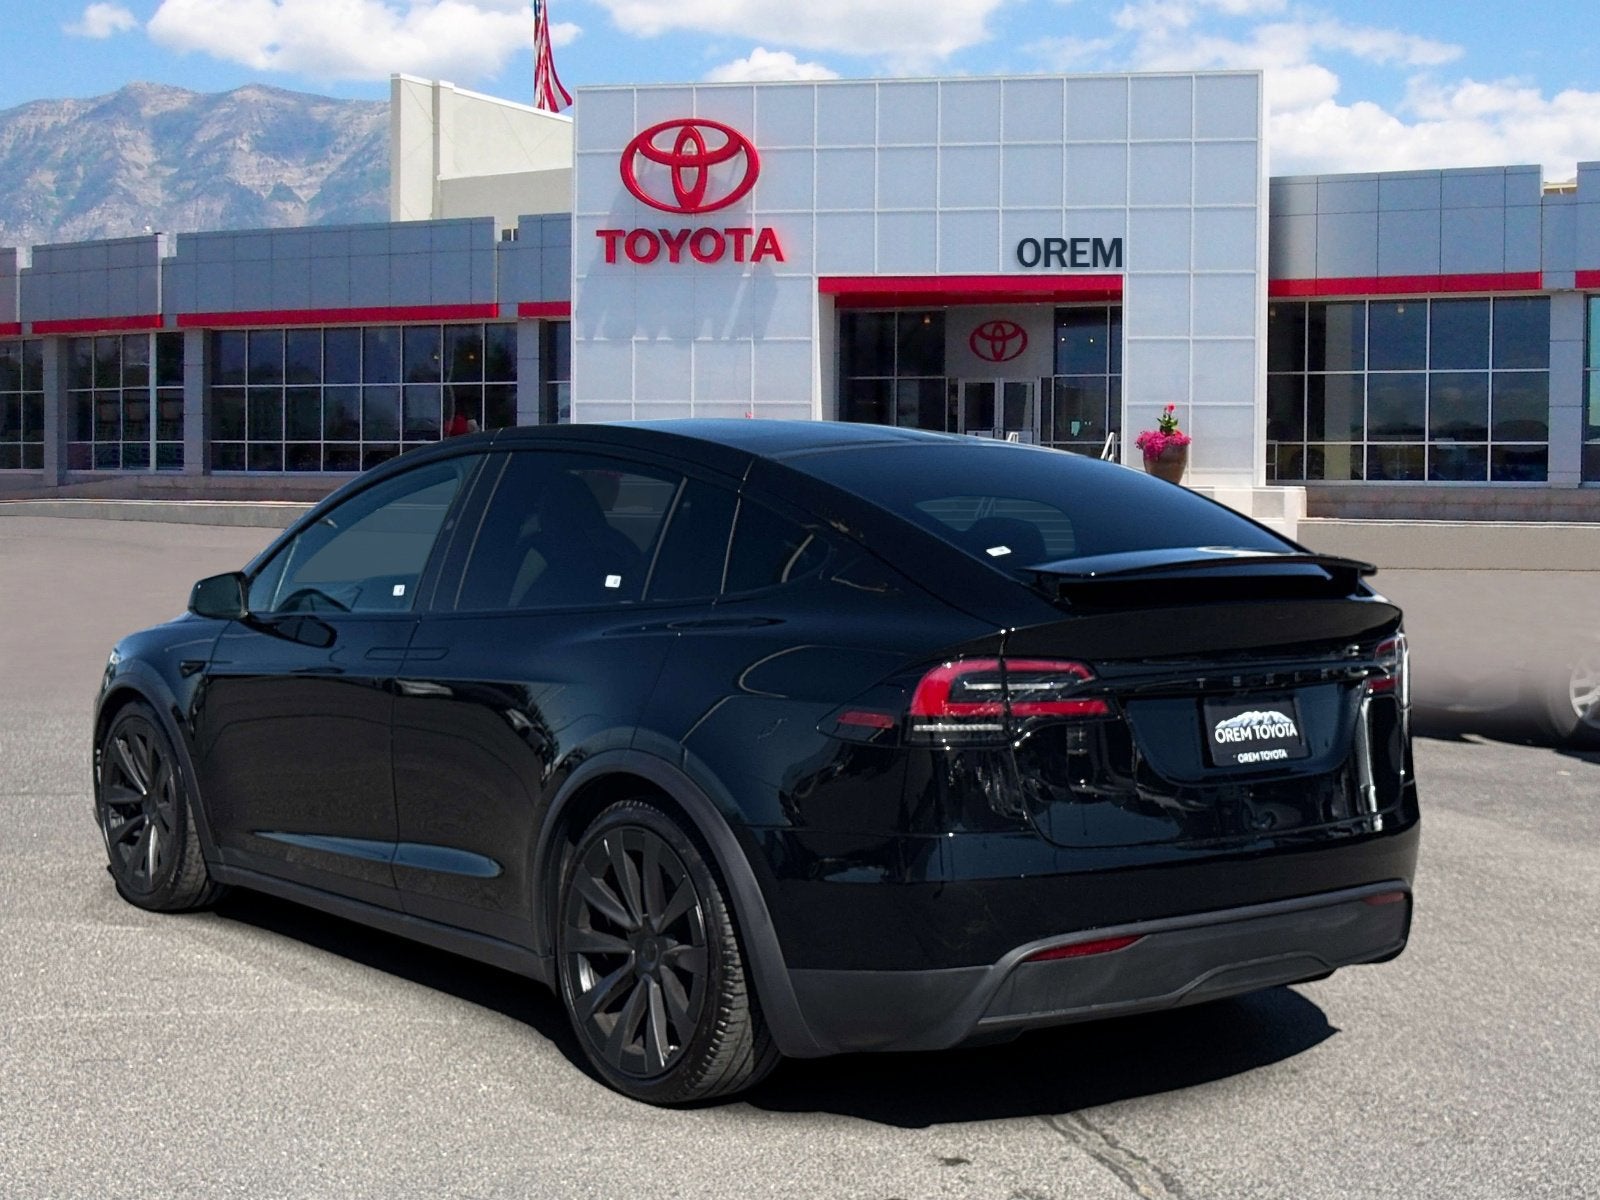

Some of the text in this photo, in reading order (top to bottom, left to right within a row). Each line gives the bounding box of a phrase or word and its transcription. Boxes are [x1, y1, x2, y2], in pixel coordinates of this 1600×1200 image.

[596, 227, 784, 264] TOYOTA
[1016, 237, 1123, 268] OREM
[1215, 724, 1298, 743] OREM TOYOTA
[1237, 749, 1288, 763] OREM TOYOTA
